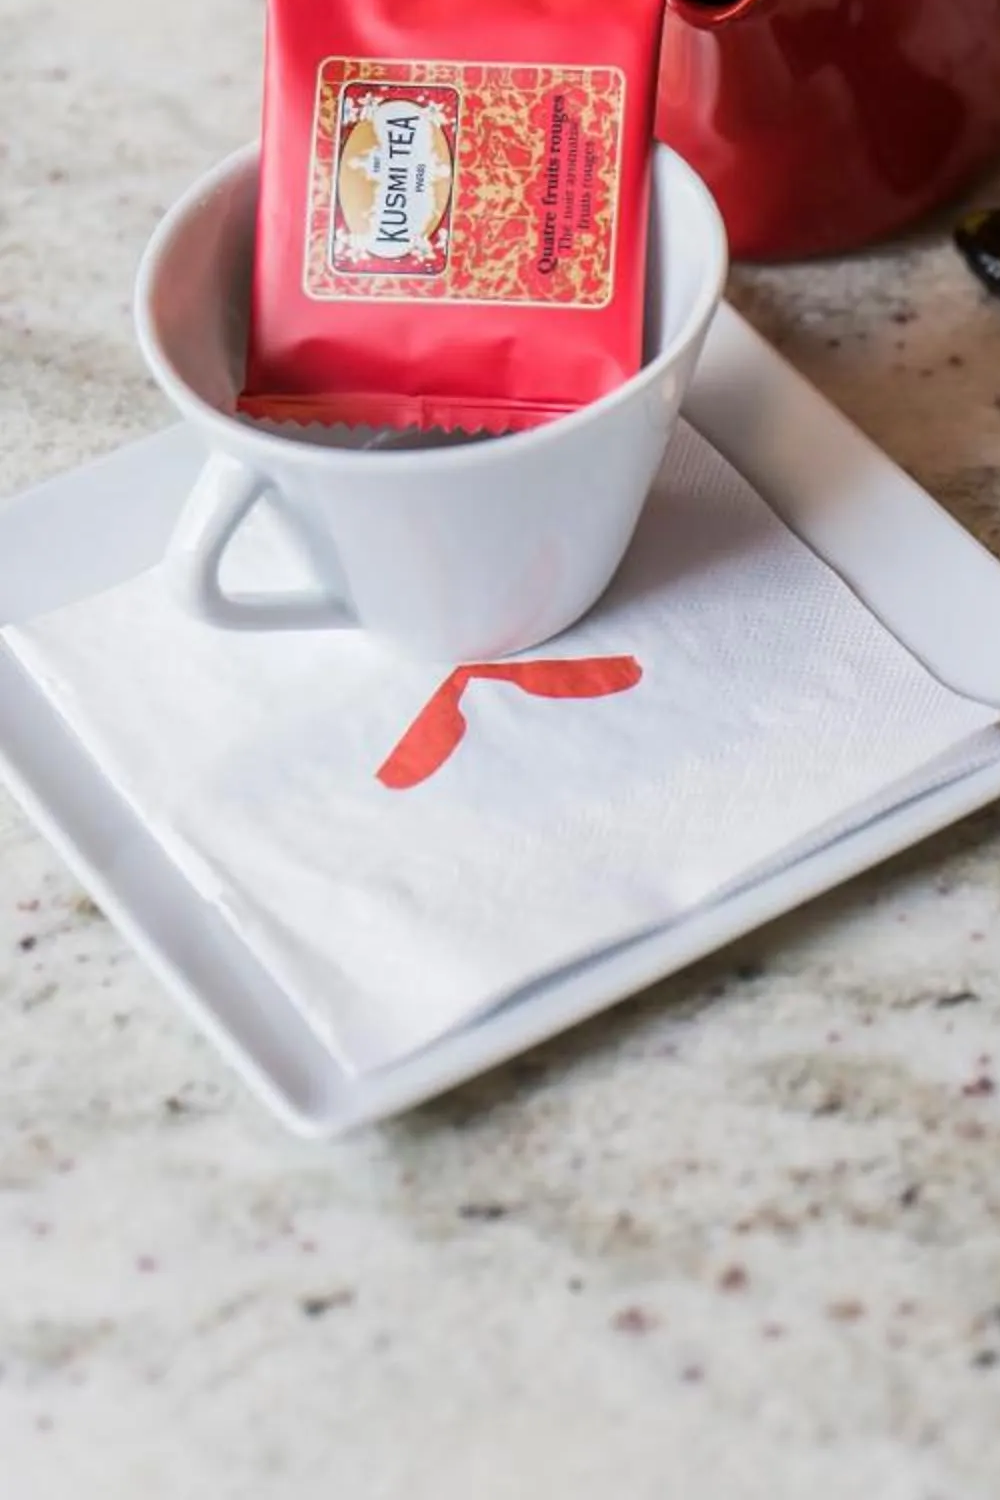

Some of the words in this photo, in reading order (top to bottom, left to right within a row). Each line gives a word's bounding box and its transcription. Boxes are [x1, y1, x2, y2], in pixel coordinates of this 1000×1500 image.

[388, 115, 420, 159] TEA
[549, 94, 568, 153] rouges
[375, 167, 411, 243] KUSMI
[541, 158, 560, 206] fruits
[537, 212, 557, 275] Quatre
